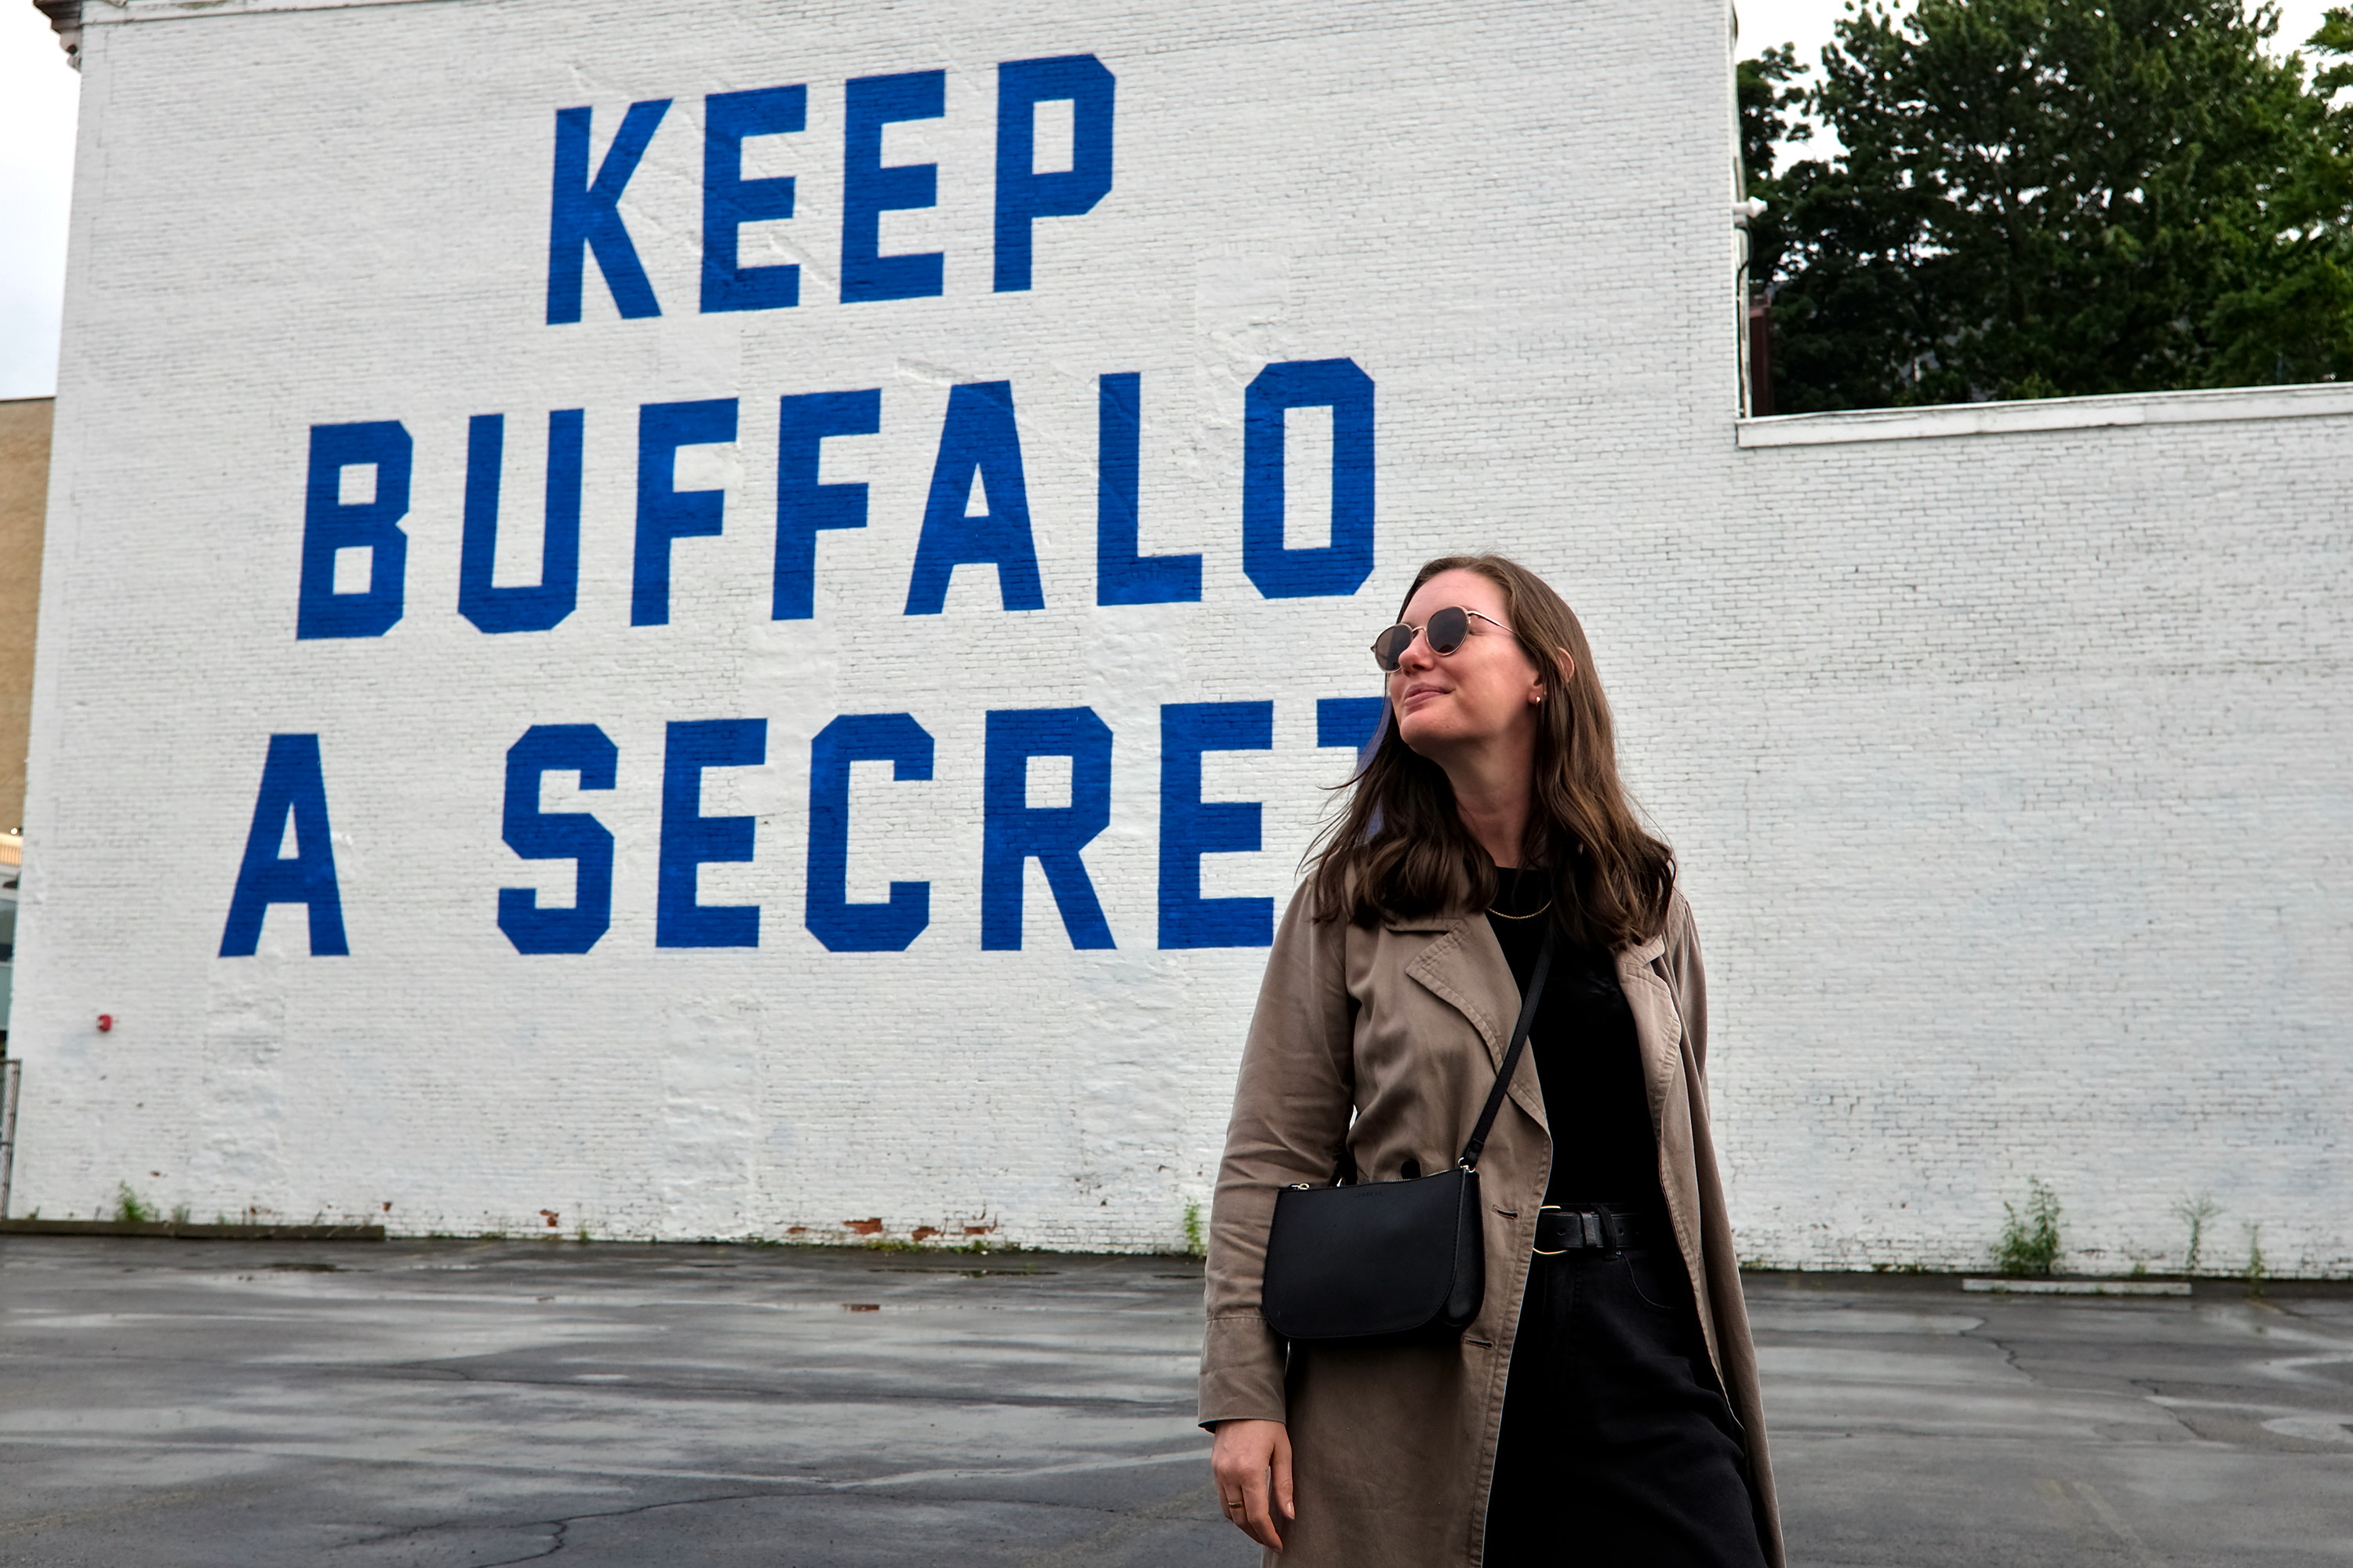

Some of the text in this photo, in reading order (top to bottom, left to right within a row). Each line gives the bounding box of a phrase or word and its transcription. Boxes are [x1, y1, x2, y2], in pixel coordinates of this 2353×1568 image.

[547, 54, 1117, 326] KEEP
[297, 358, 1377, 640] BUFFALO
[220, 733, 350, 957] A
